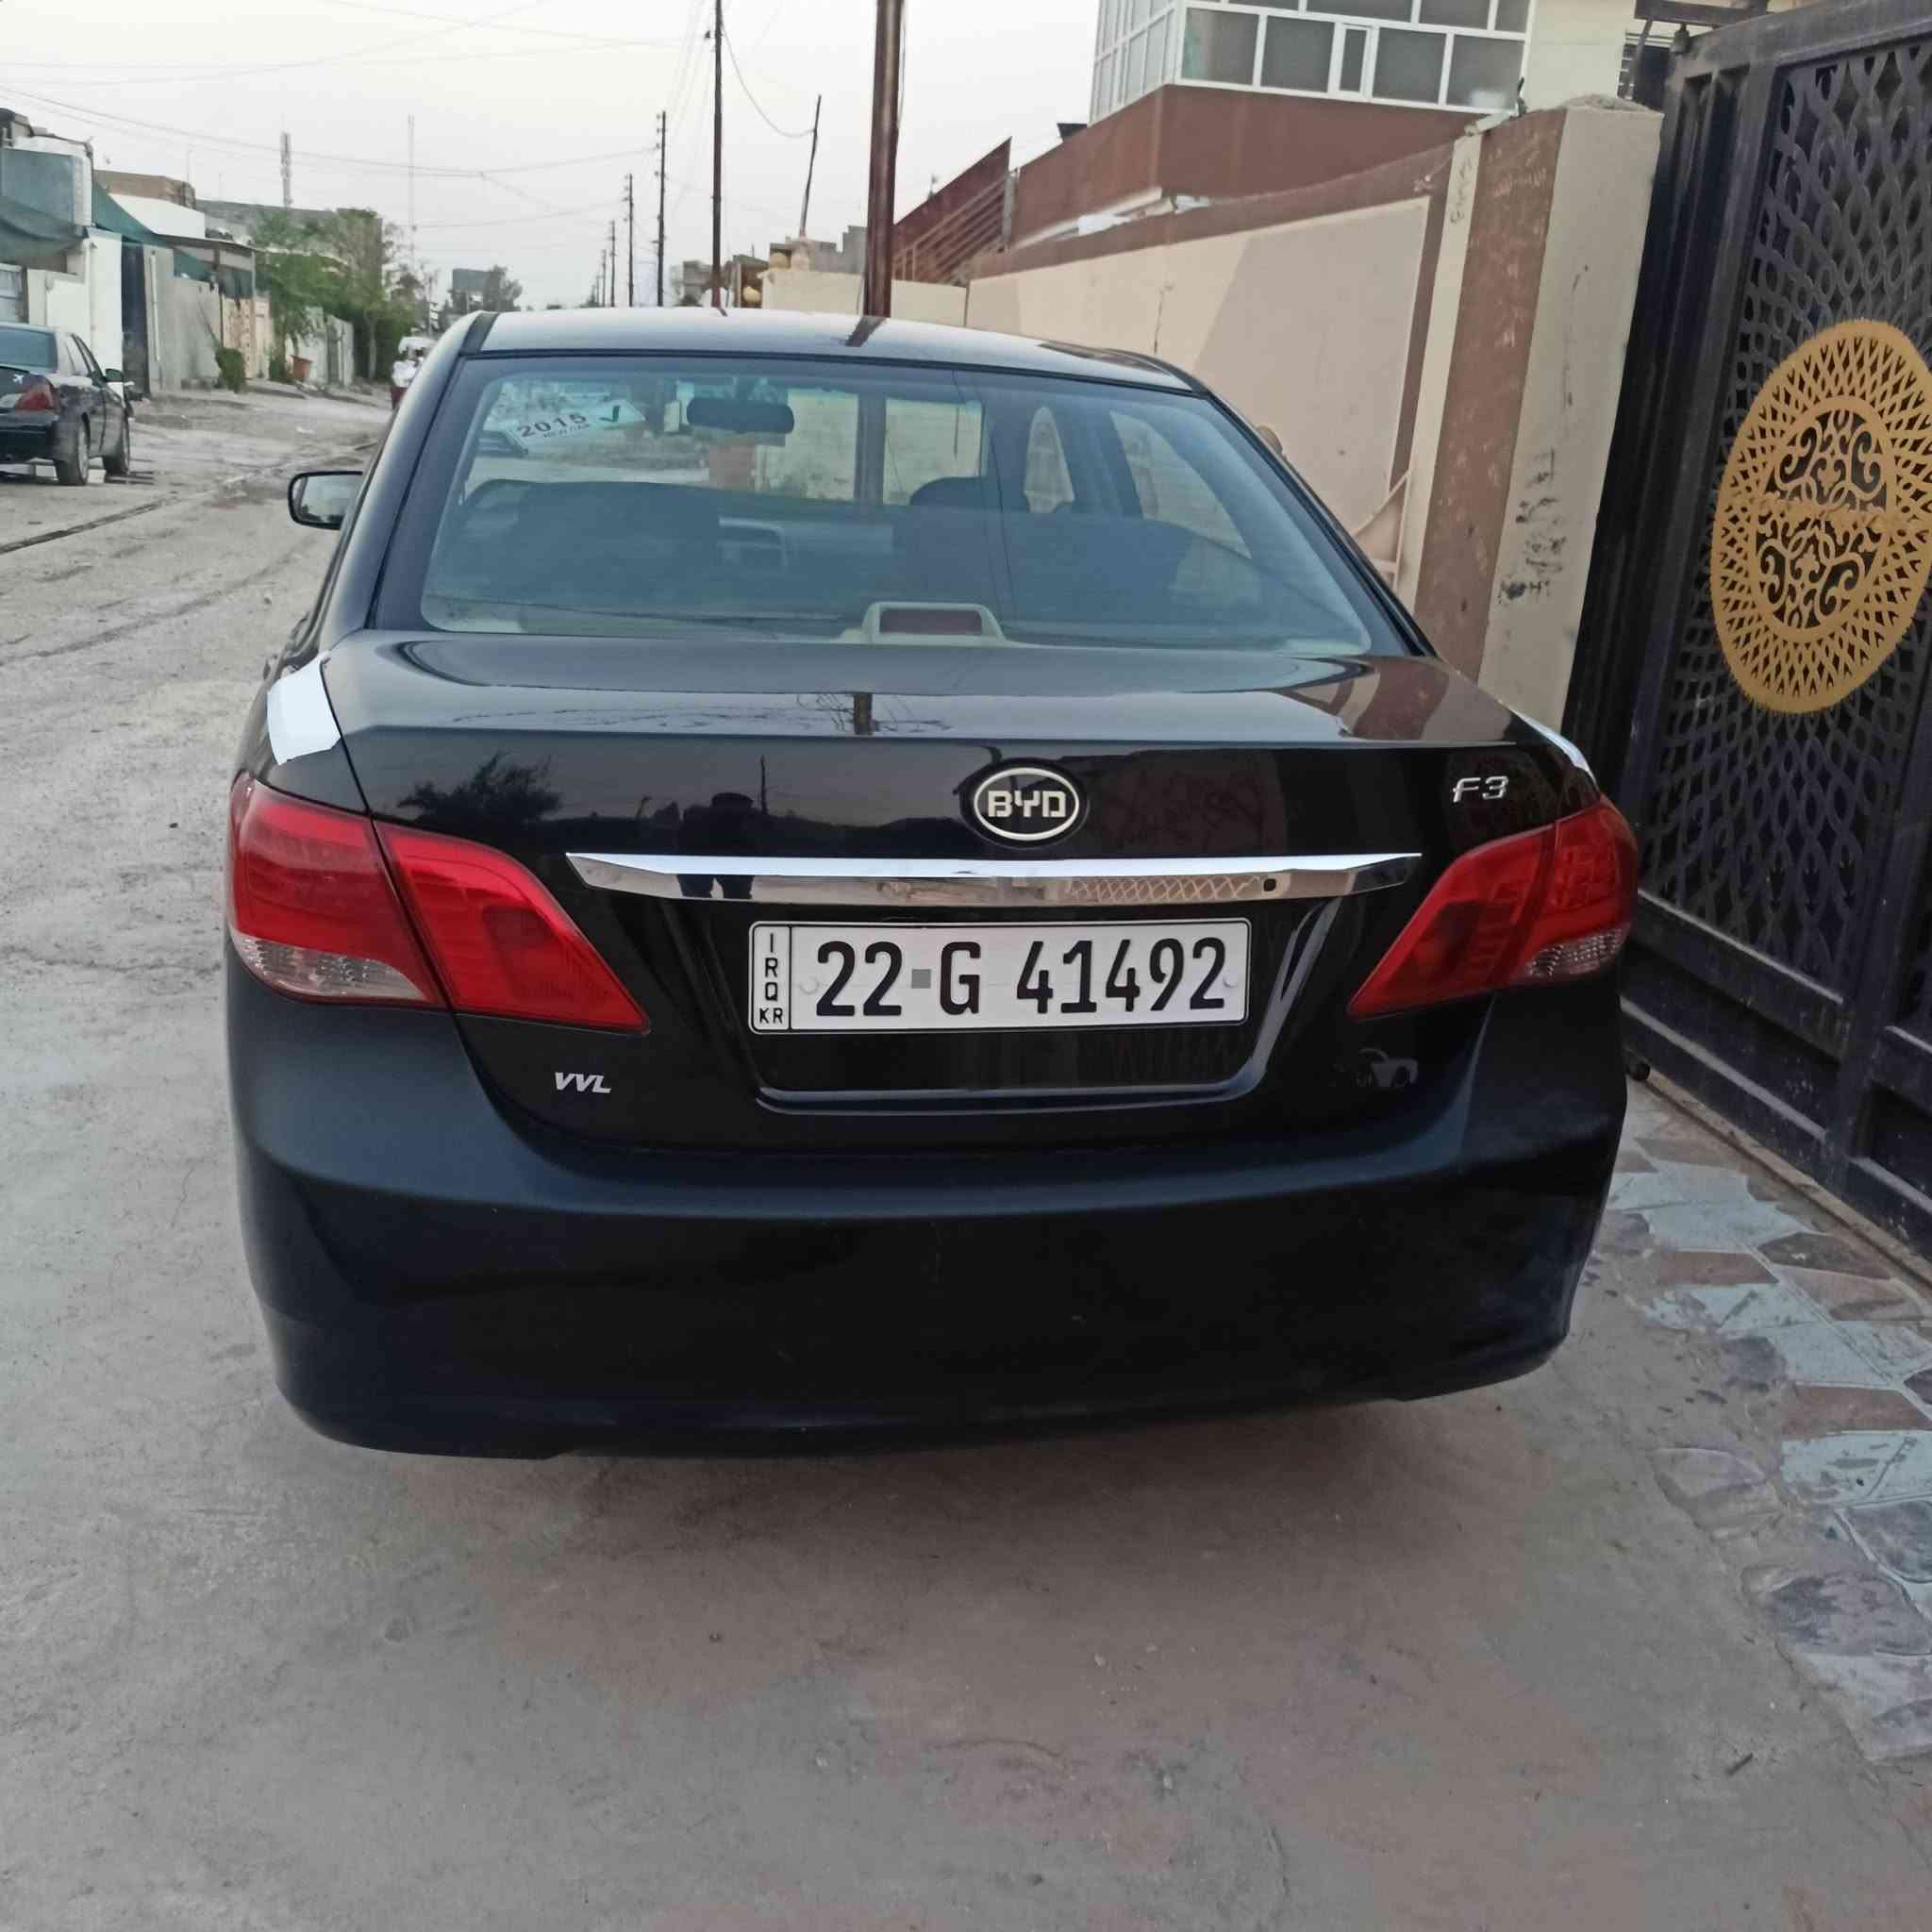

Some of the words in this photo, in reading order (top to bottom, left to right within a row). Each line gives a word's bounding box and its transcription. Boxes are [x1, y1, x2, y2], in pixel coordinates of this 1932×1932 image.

[516, 413, 587, 438] 2015
[1452, 775, 1509, 803] F3
[987, 790, 1066, 818] BYD
[815, 941, 903, 1017] 22
[940, 941, 982, 1016] G
[1016, 937, 1226, 1015] 41492
[758, 1007, 783, 1024] KR
